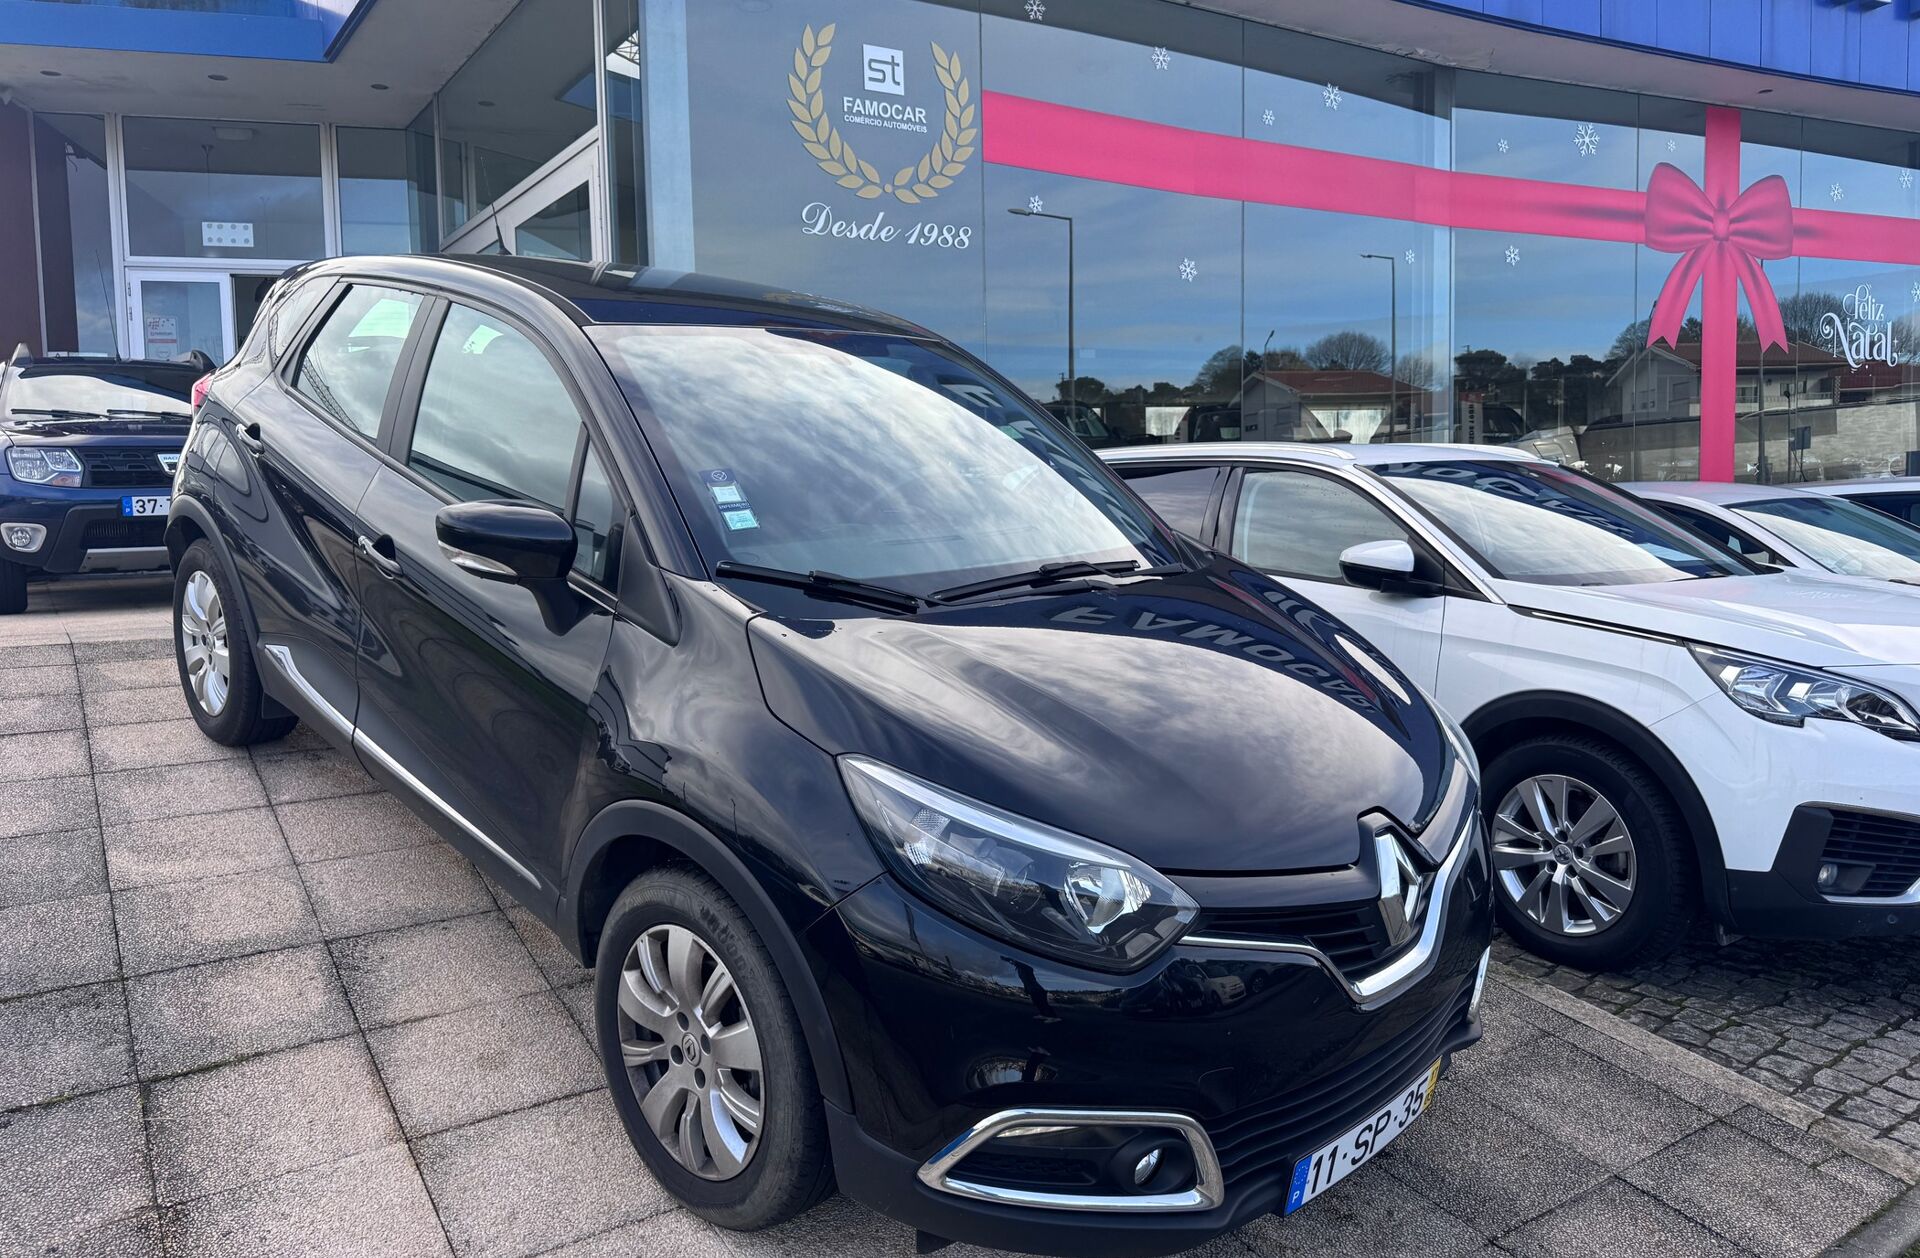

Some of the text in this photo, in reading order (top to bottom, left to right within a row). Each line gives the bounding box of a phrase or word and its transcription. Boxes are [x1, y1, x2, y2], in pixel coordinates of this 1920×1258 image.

[867, 54, 901, 86] st
[843, 97, 927, 124] FAMOCAR
[844, 114, 928, 134] COMÉRCIO AUTOMÓVEIS
[801, 202, 972, 249] Desde 1988
[1820, 312, 1898, 368] Natal
[1291, 1190, 1300, 1204] P
